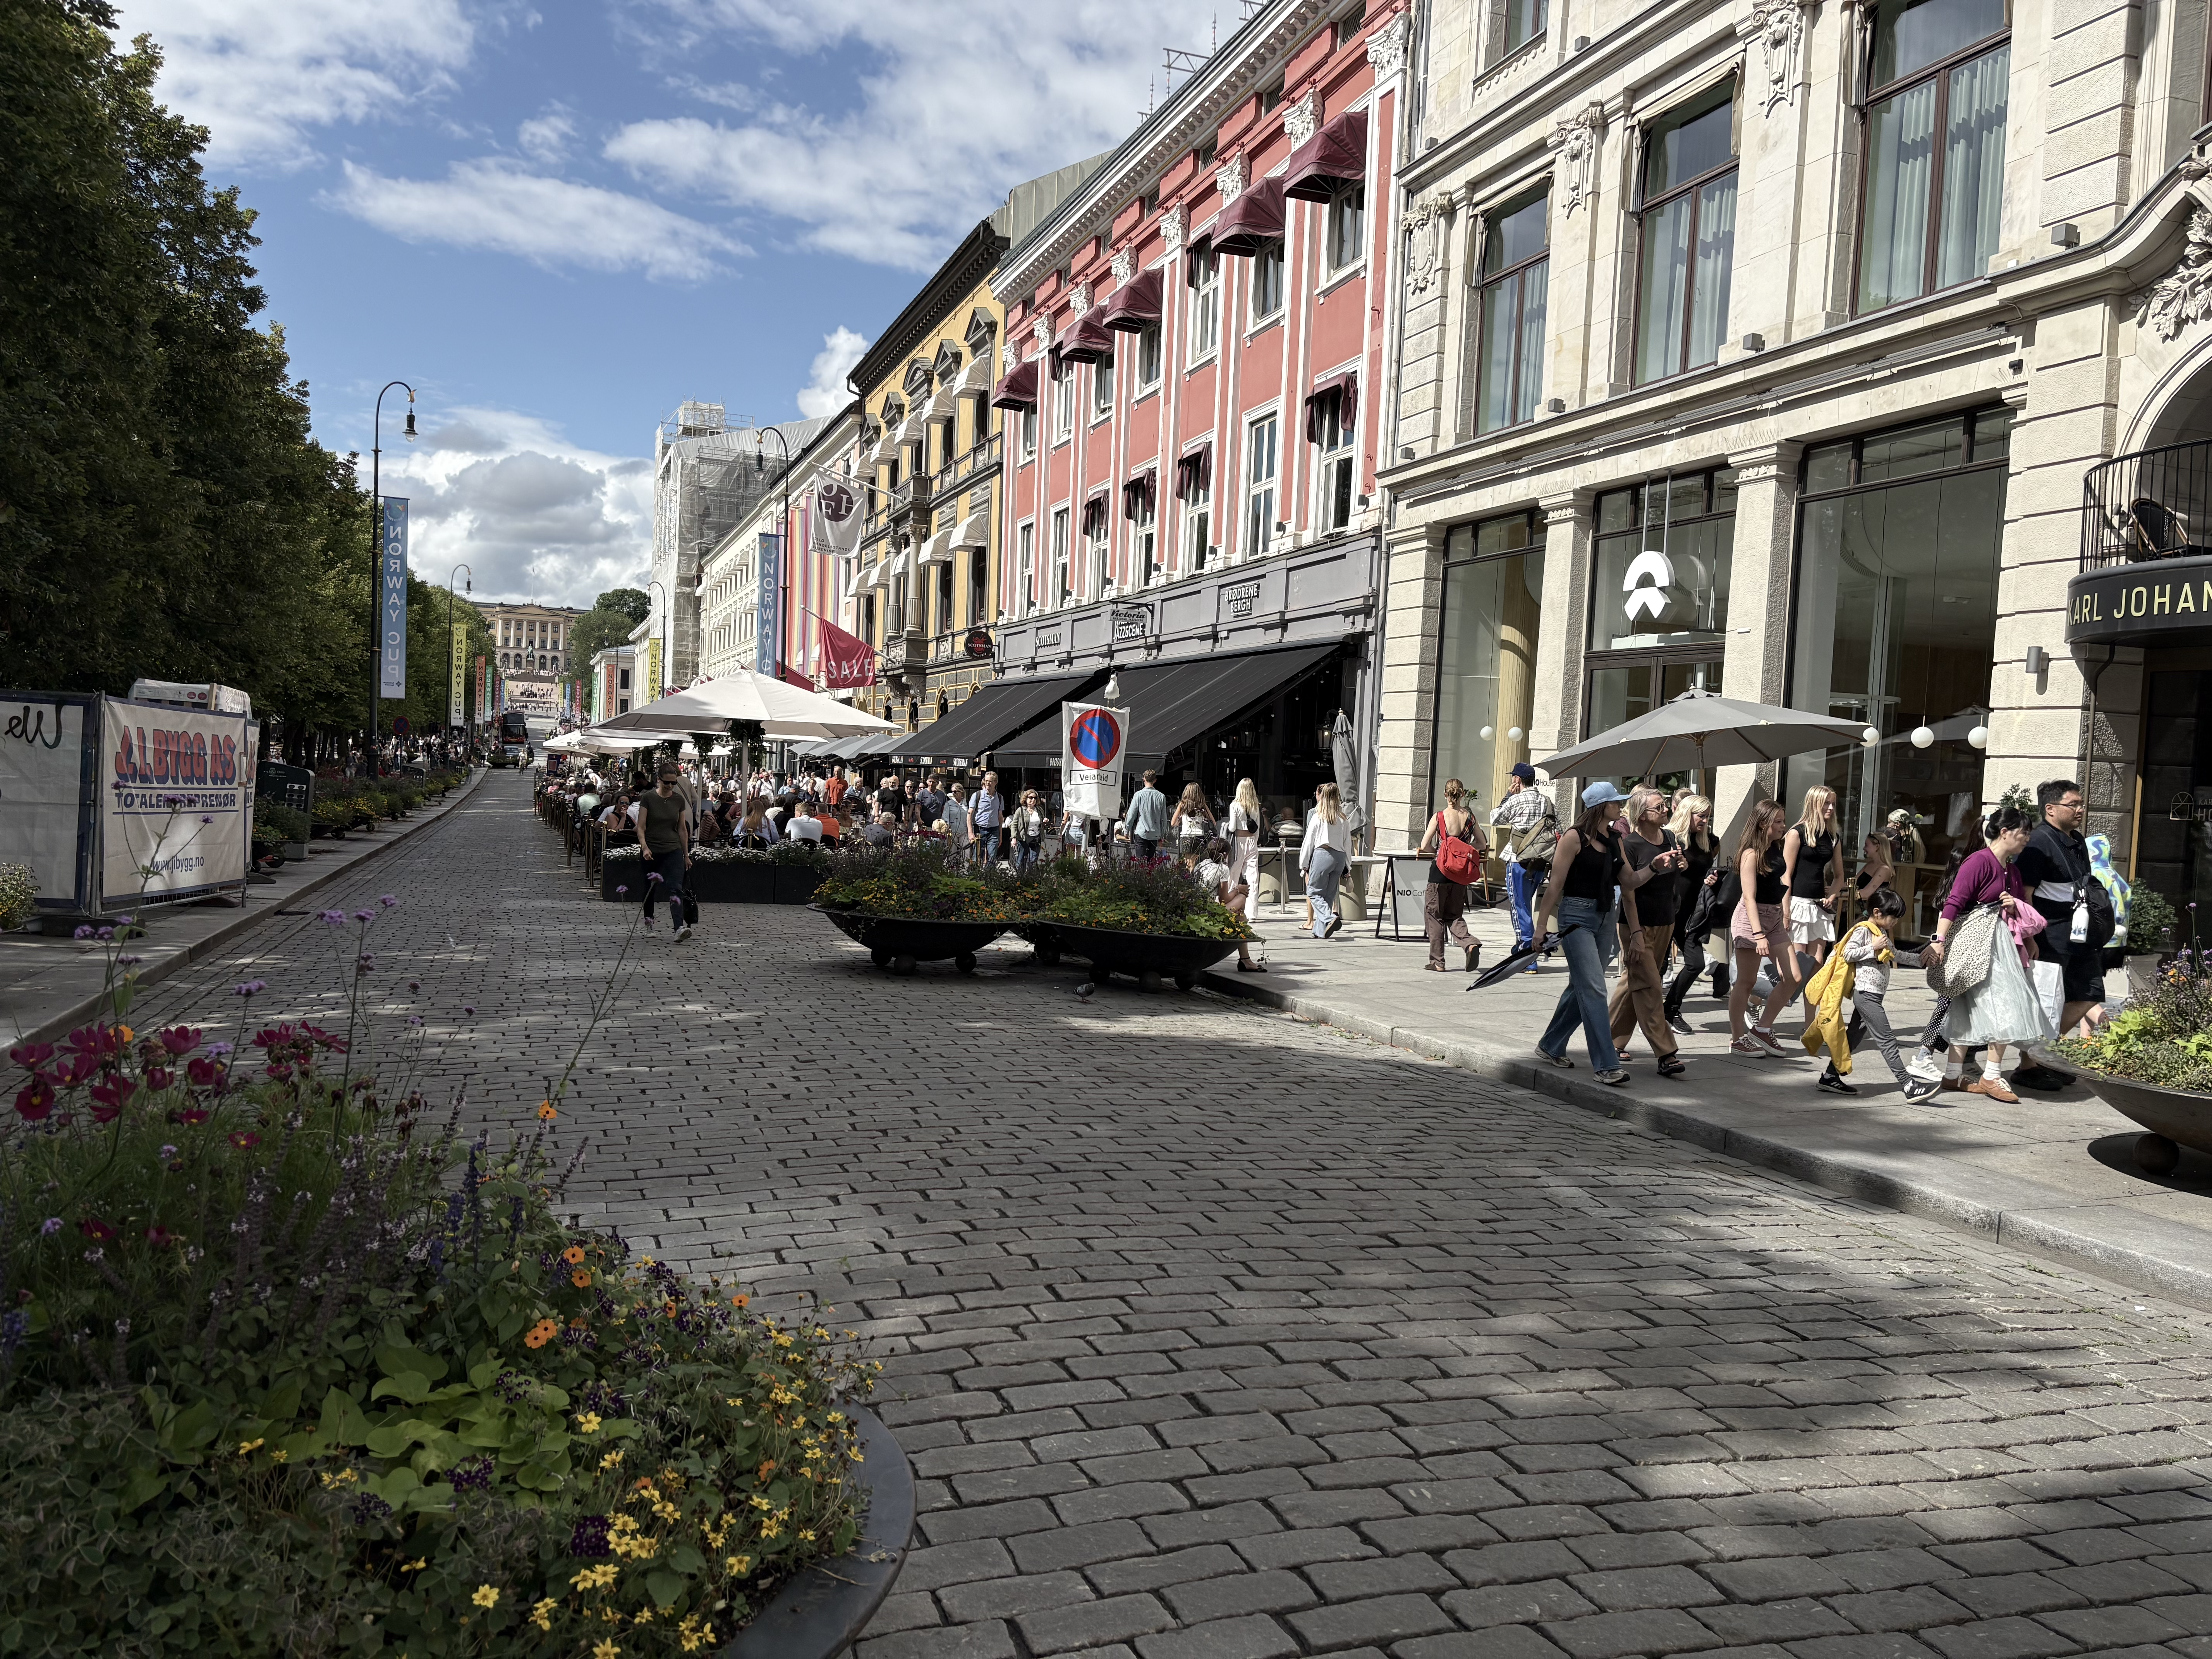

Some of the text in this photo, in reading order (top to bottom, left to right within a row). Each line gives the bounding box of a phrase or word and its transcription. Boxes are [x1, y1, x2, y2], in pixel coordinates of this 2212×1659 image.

[1225, 584, 1257, 601] BRØDRENE
[761, 562, 774, 651] NORWAY
[1230, 598, 1250, 612] BERGH
[2068, 592, 2102, 627] KARL
[1111, 610, 1146, 619] Victoria
[1113, 622, 1143, 640] JAZZSCENE
[828, 659, 873, 679] SALE
[1540, 779, 1555, 787] House
